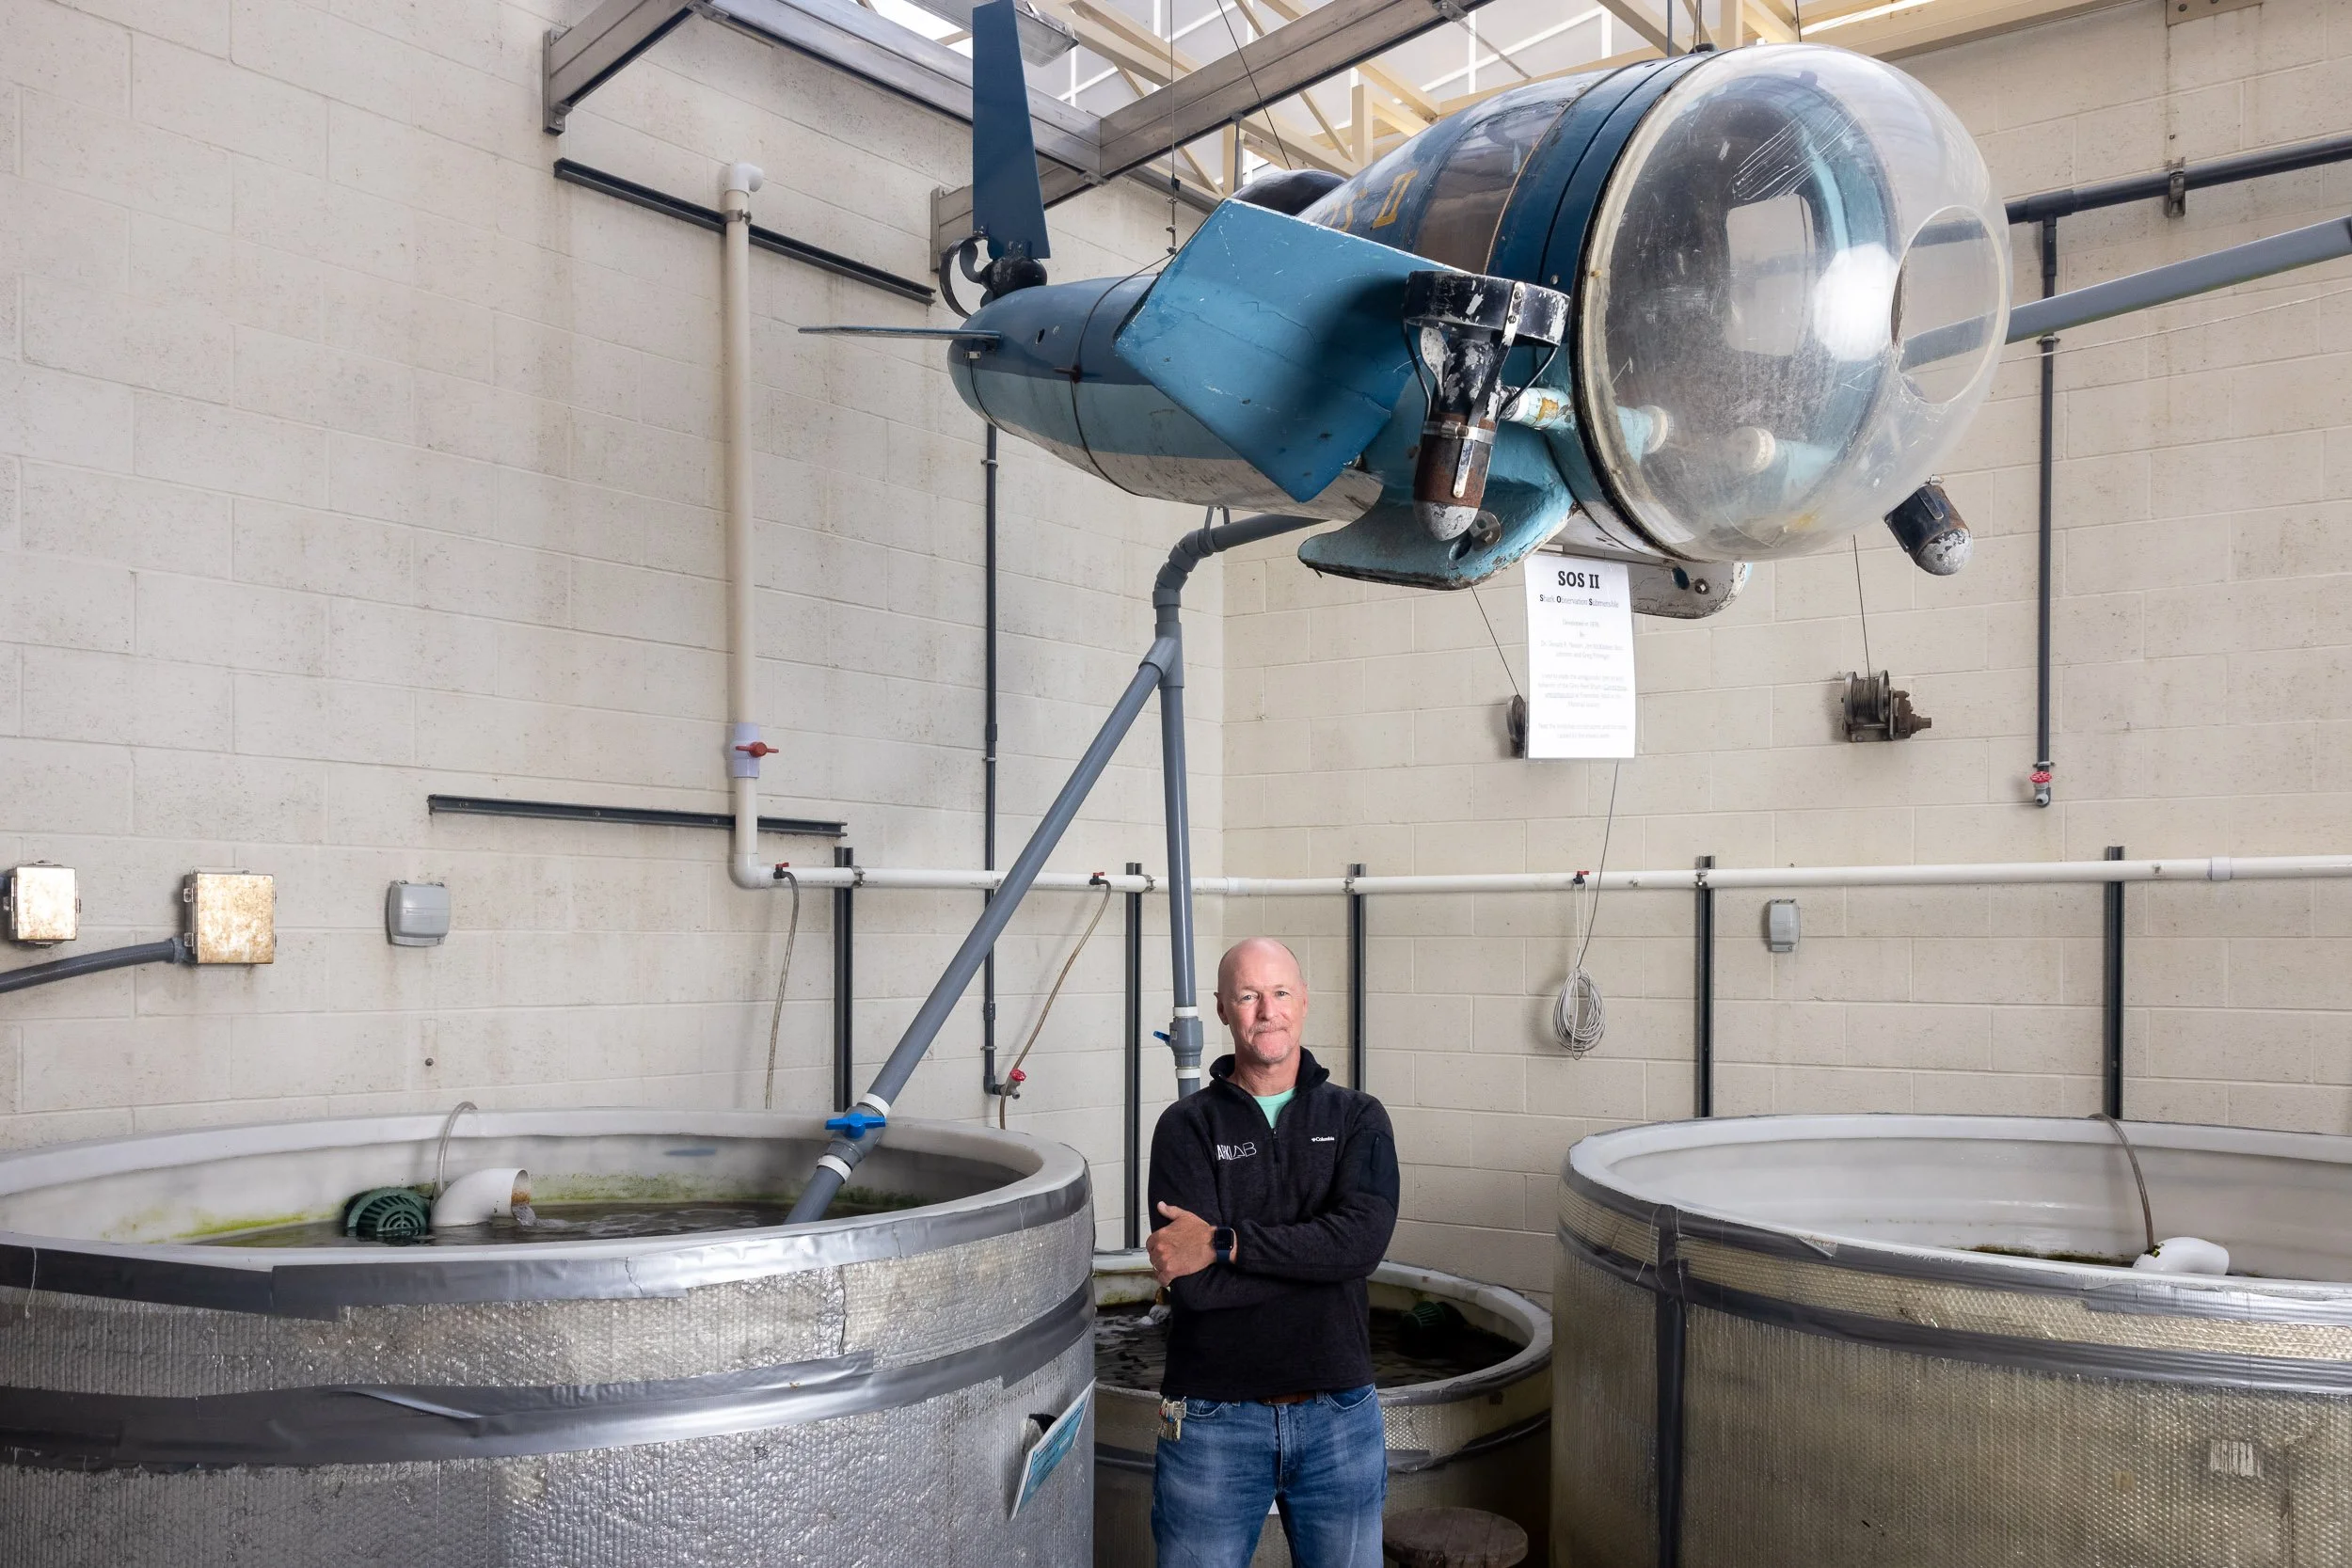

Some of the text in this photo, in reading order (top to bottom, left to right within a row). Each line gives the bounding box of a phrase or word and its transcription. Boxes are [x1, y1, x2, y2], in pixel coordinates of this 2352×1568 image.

[1558, 571, 1599, 589] SOS II
[1539, 594, 1555, 603] Shark
[1556, 595, 1588, 606] Observation
